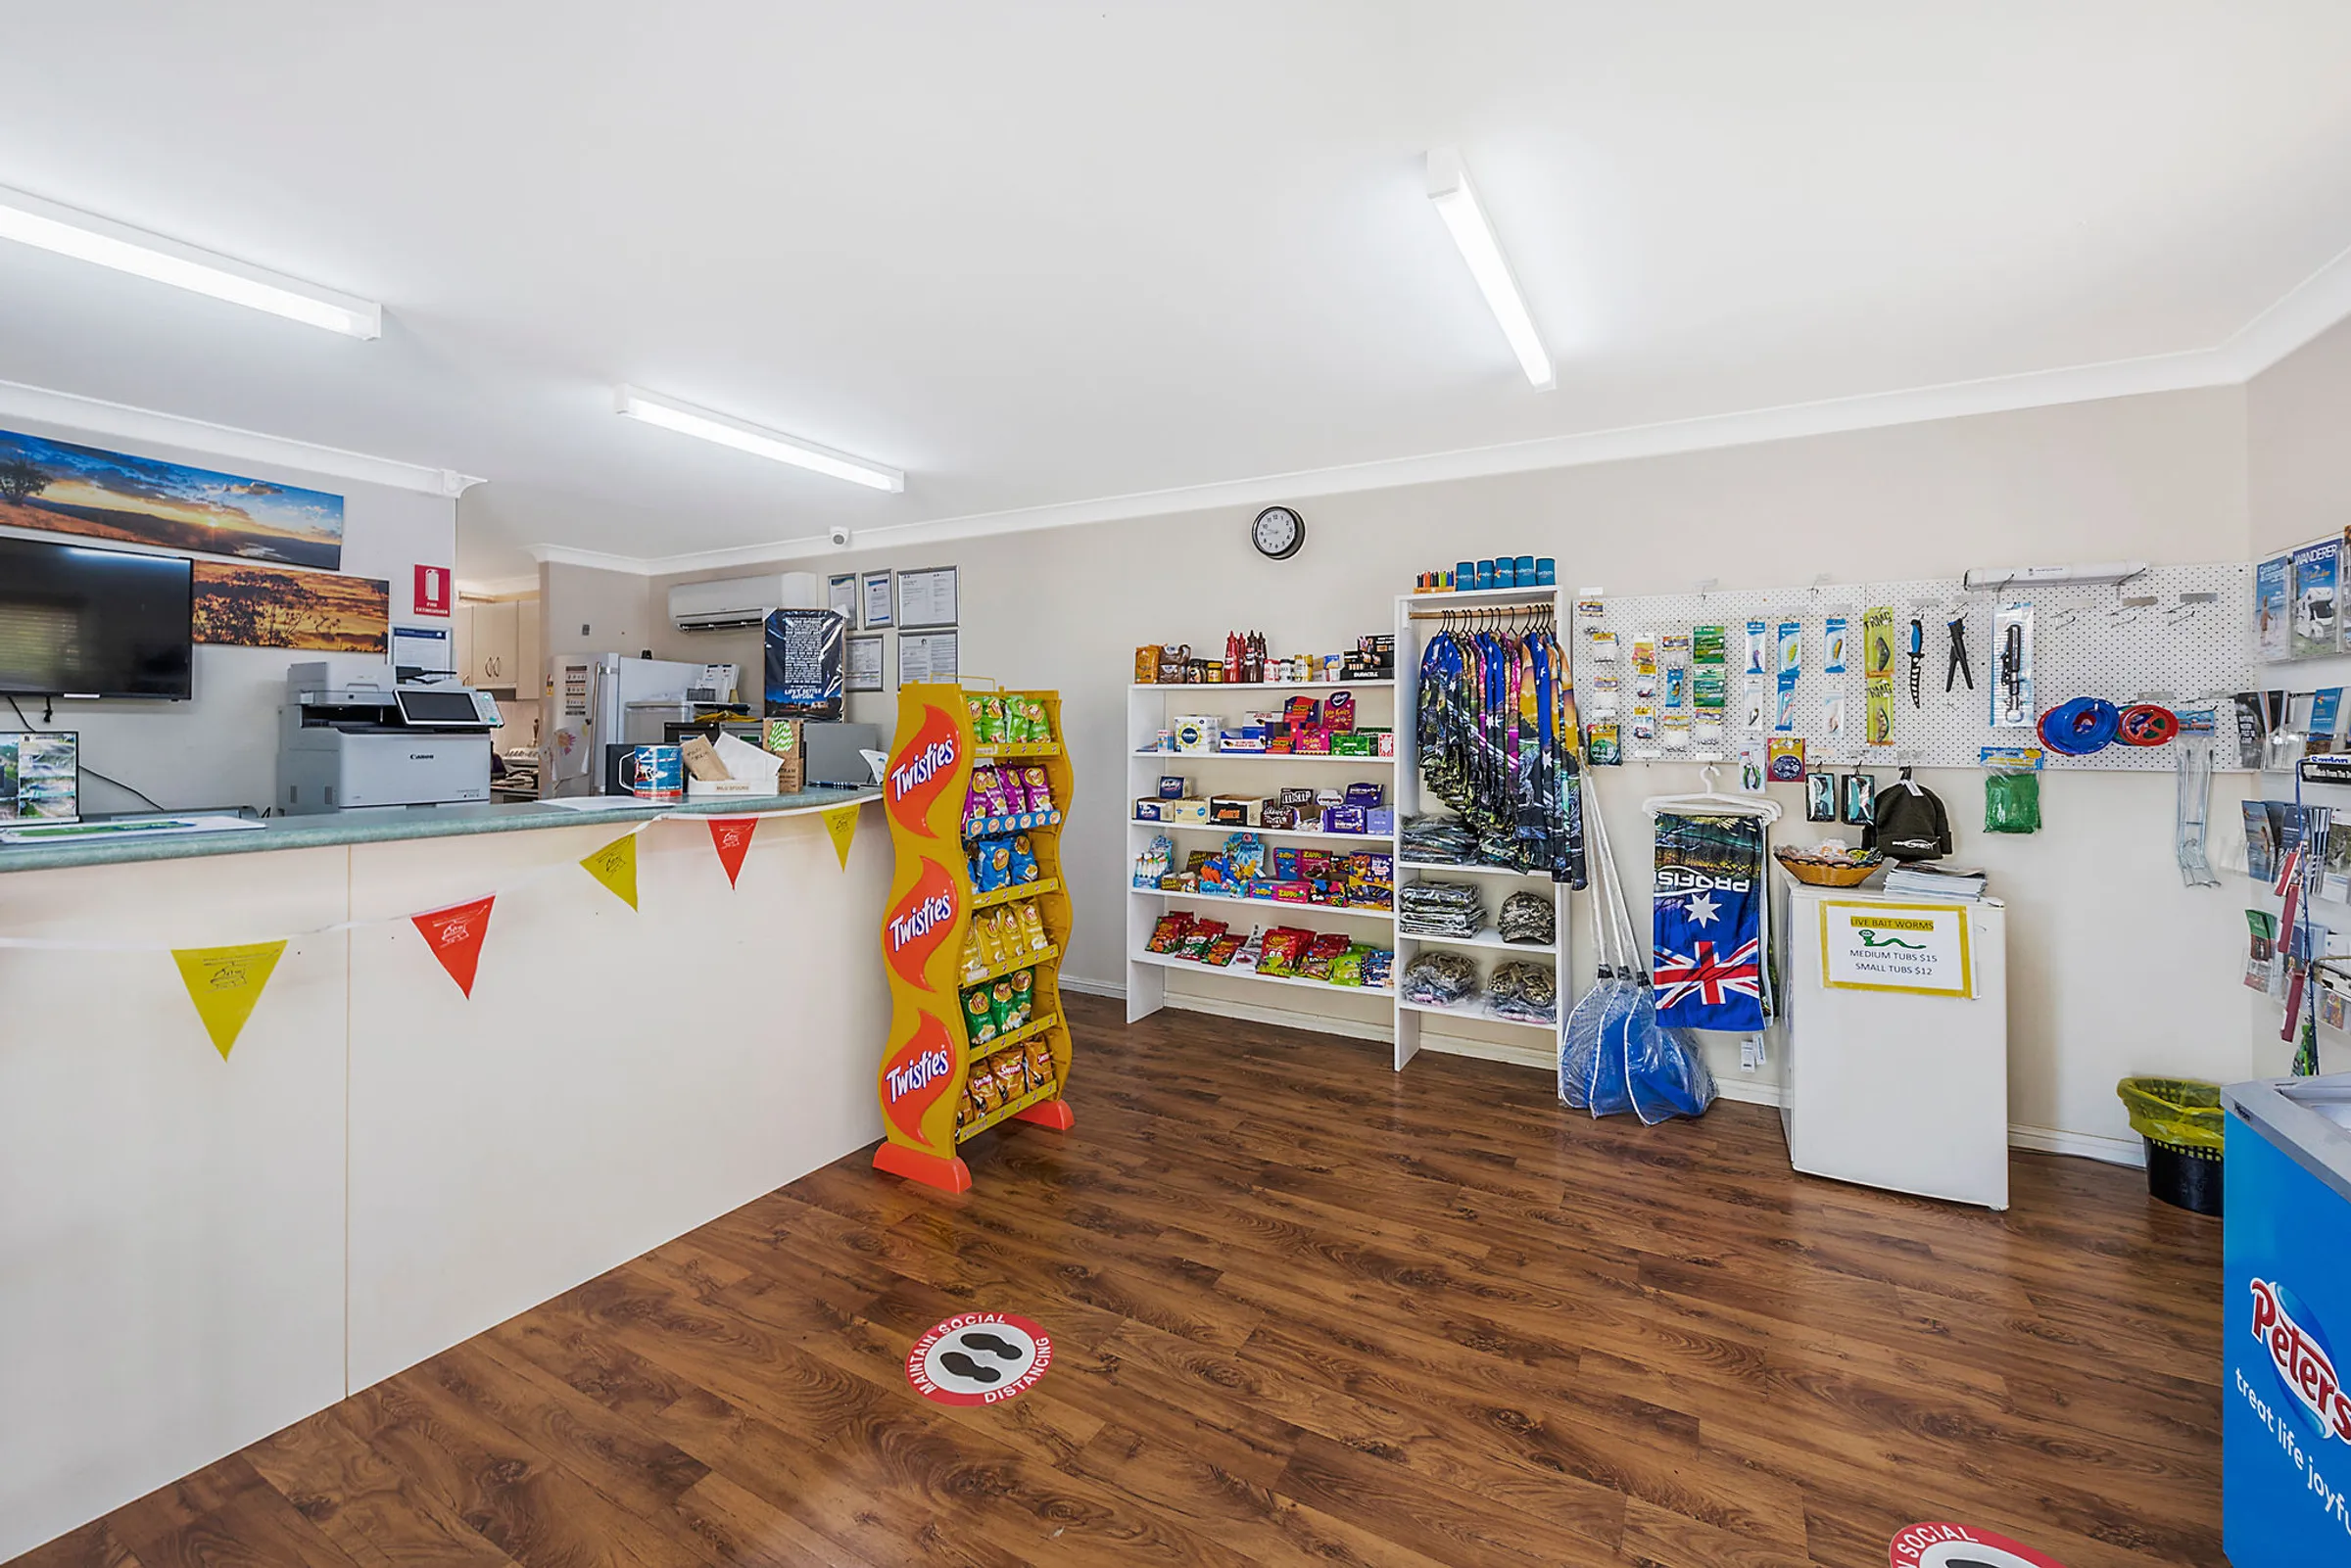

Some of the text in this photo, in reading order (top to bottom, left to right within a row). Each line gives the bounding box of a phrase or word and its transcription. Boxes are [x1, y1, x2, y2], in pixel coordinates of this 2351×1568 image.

[2294, 544, 2337, 565] WANDERER
[889, 732, 956, 796] Twisties
[1654, 871, 1751, 893] PROFIS
[888, 888, 953, 953] Twisties
[1850, 918, 1935, 930] LIVE BAIT WORMS
[1849, 949, 1938, 963] MEDIUM TUBS $15
[1855, 963, 1933, 975] SMALL TUBS $12
[885, 1041, 950, 1104] Twisties
[909, 1313, 1050, 1403] MAINTAIN SOCIAL DISTANCING
[2250, 1277, 2351, 1445] Peters
[2235, 1367, 2274, 1434] treat
[2278, 1417, 2304, 1470] life
[1897, 1525, 1979, 1558] SOCIAL
